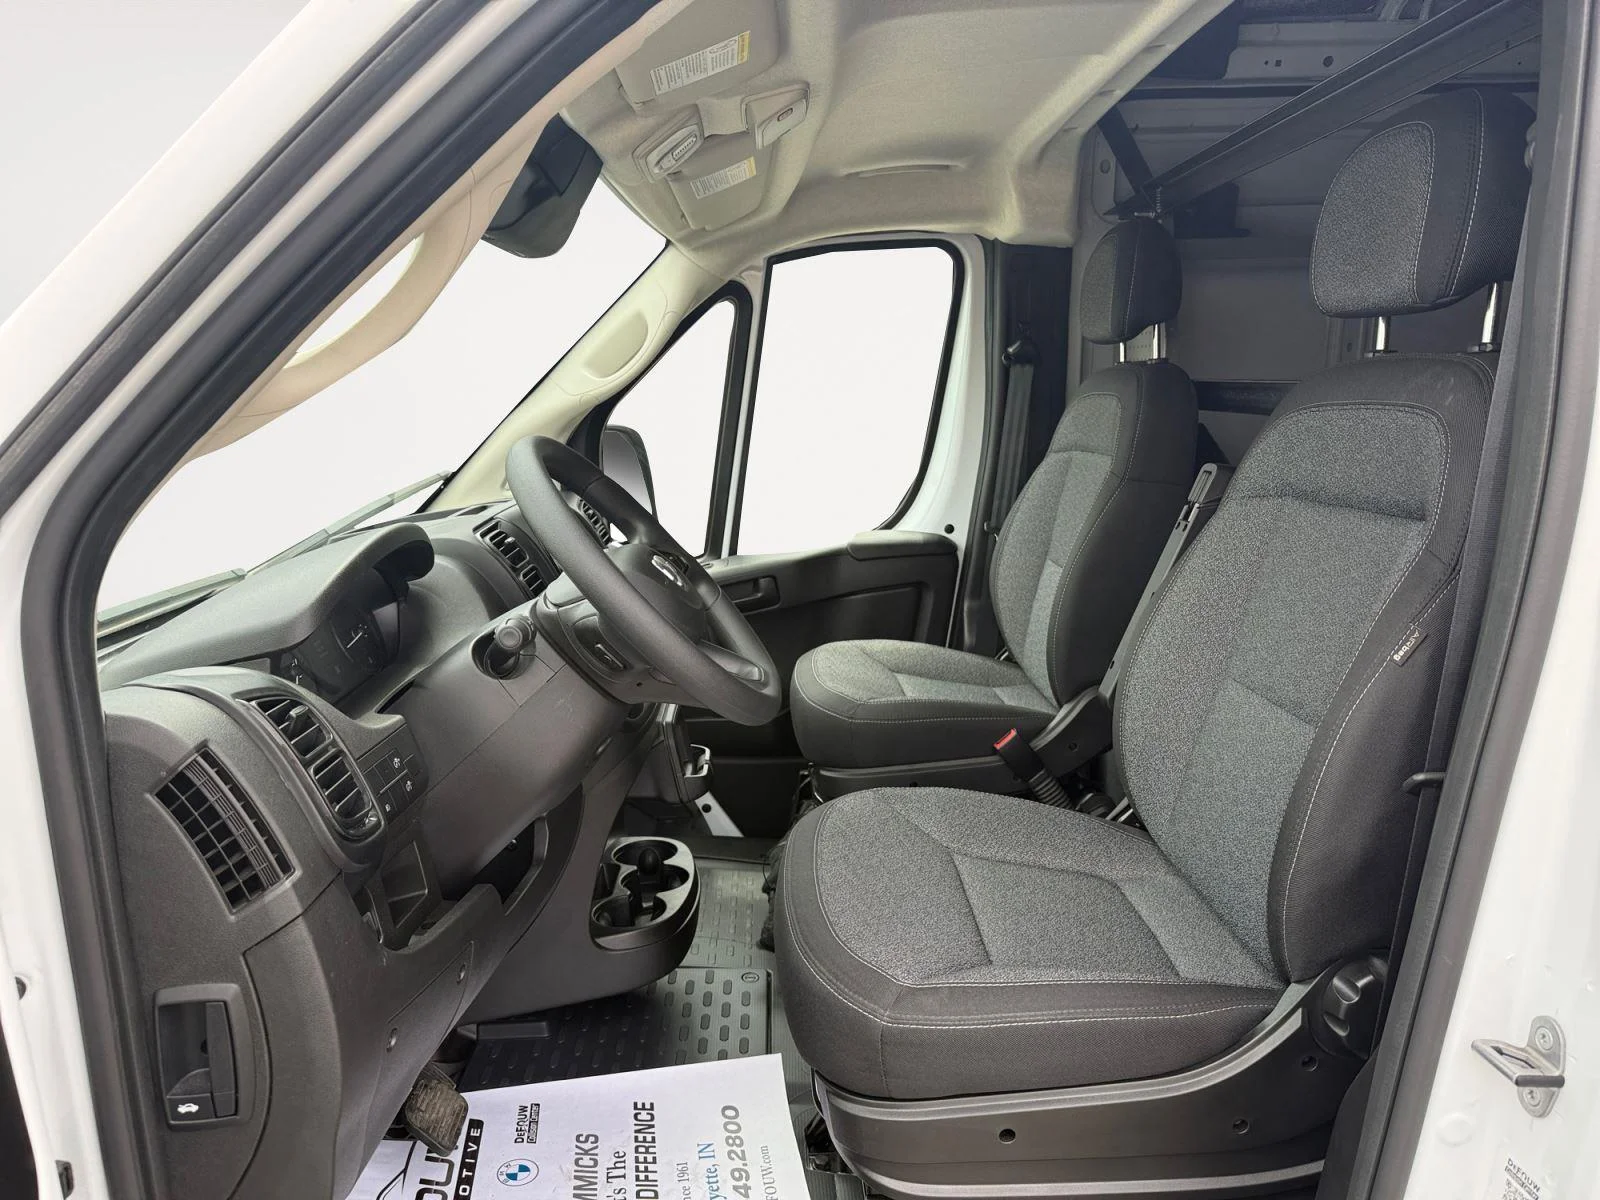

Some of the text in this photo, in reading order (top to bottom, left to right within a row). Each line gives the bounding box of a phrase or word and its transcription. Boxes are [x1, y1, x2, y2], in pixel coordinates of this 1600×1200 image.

[458, 1127, 481, 1196] OTIVE
[606, 1150, 626, 1183] The
[633, 1101, 659, 1200] DIFFERENCE
[676, 1162, 690, 1182] 1961
[697, 1142, 716, 1160] IN
[721, 1105, 752, 1199] 49.2800
